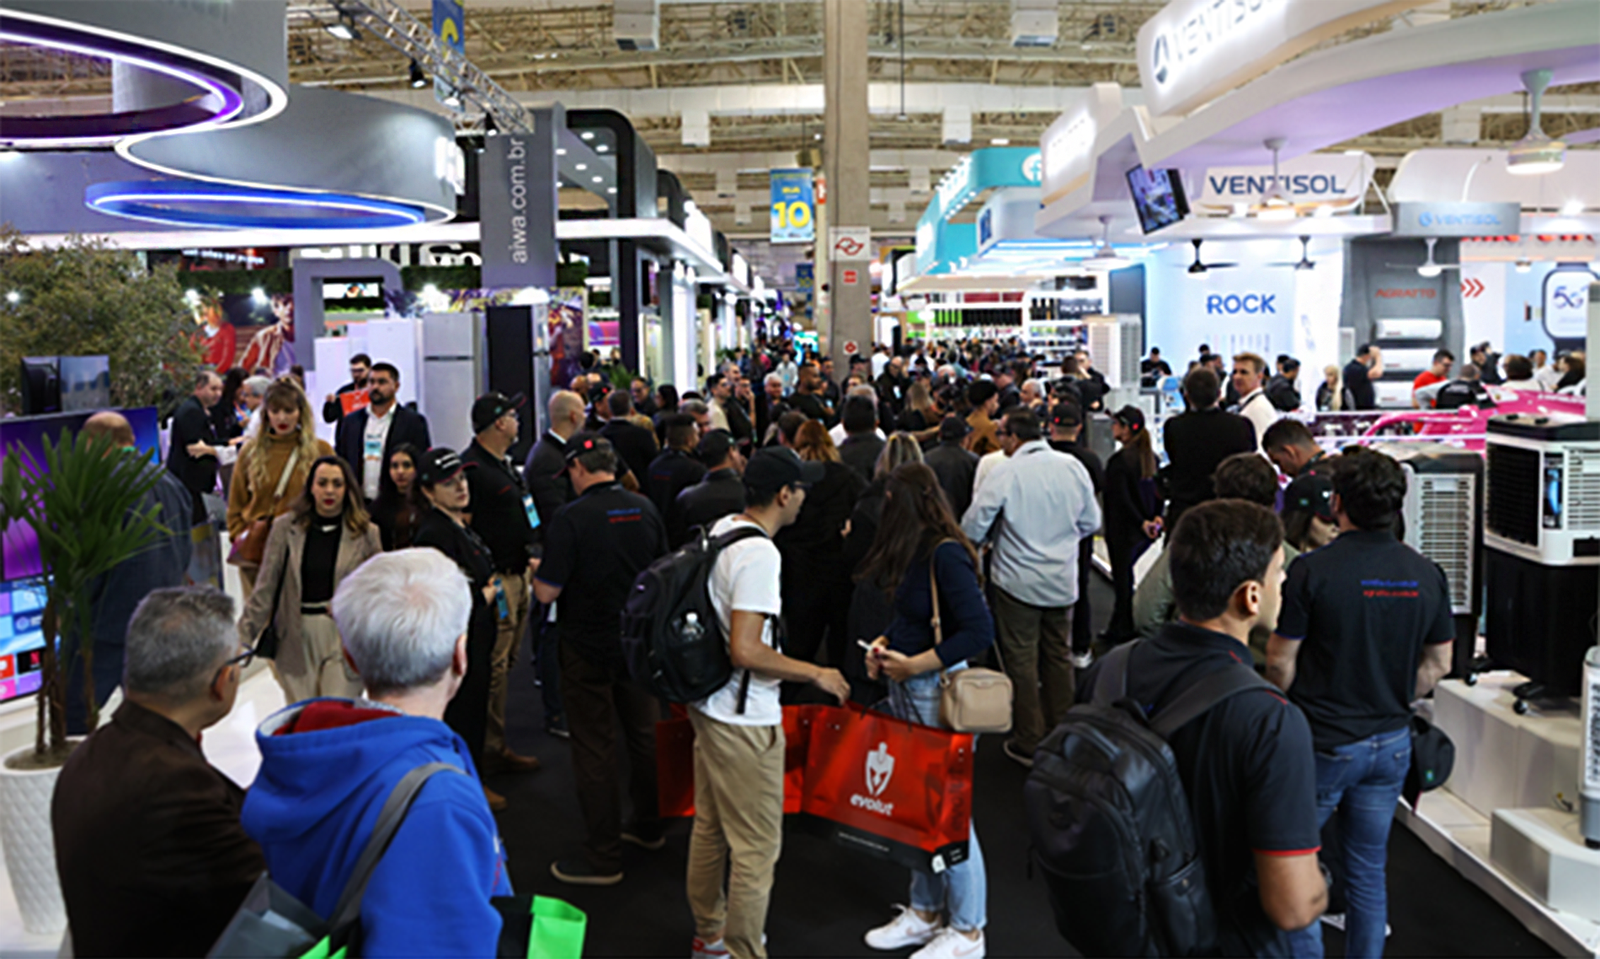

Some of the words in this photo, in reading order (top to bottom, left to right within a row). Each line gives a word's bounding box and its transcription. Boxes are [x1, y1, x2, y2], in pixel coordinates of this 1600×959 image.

[1173, 0, 1274, 61] VENTISO
[507, 138, 528, 263] aiwa.com.br
[773, 201, 811, 228] 10
[1206, 293, 1276, 314] ROCK
[850, 794, 894, 817] evolut
